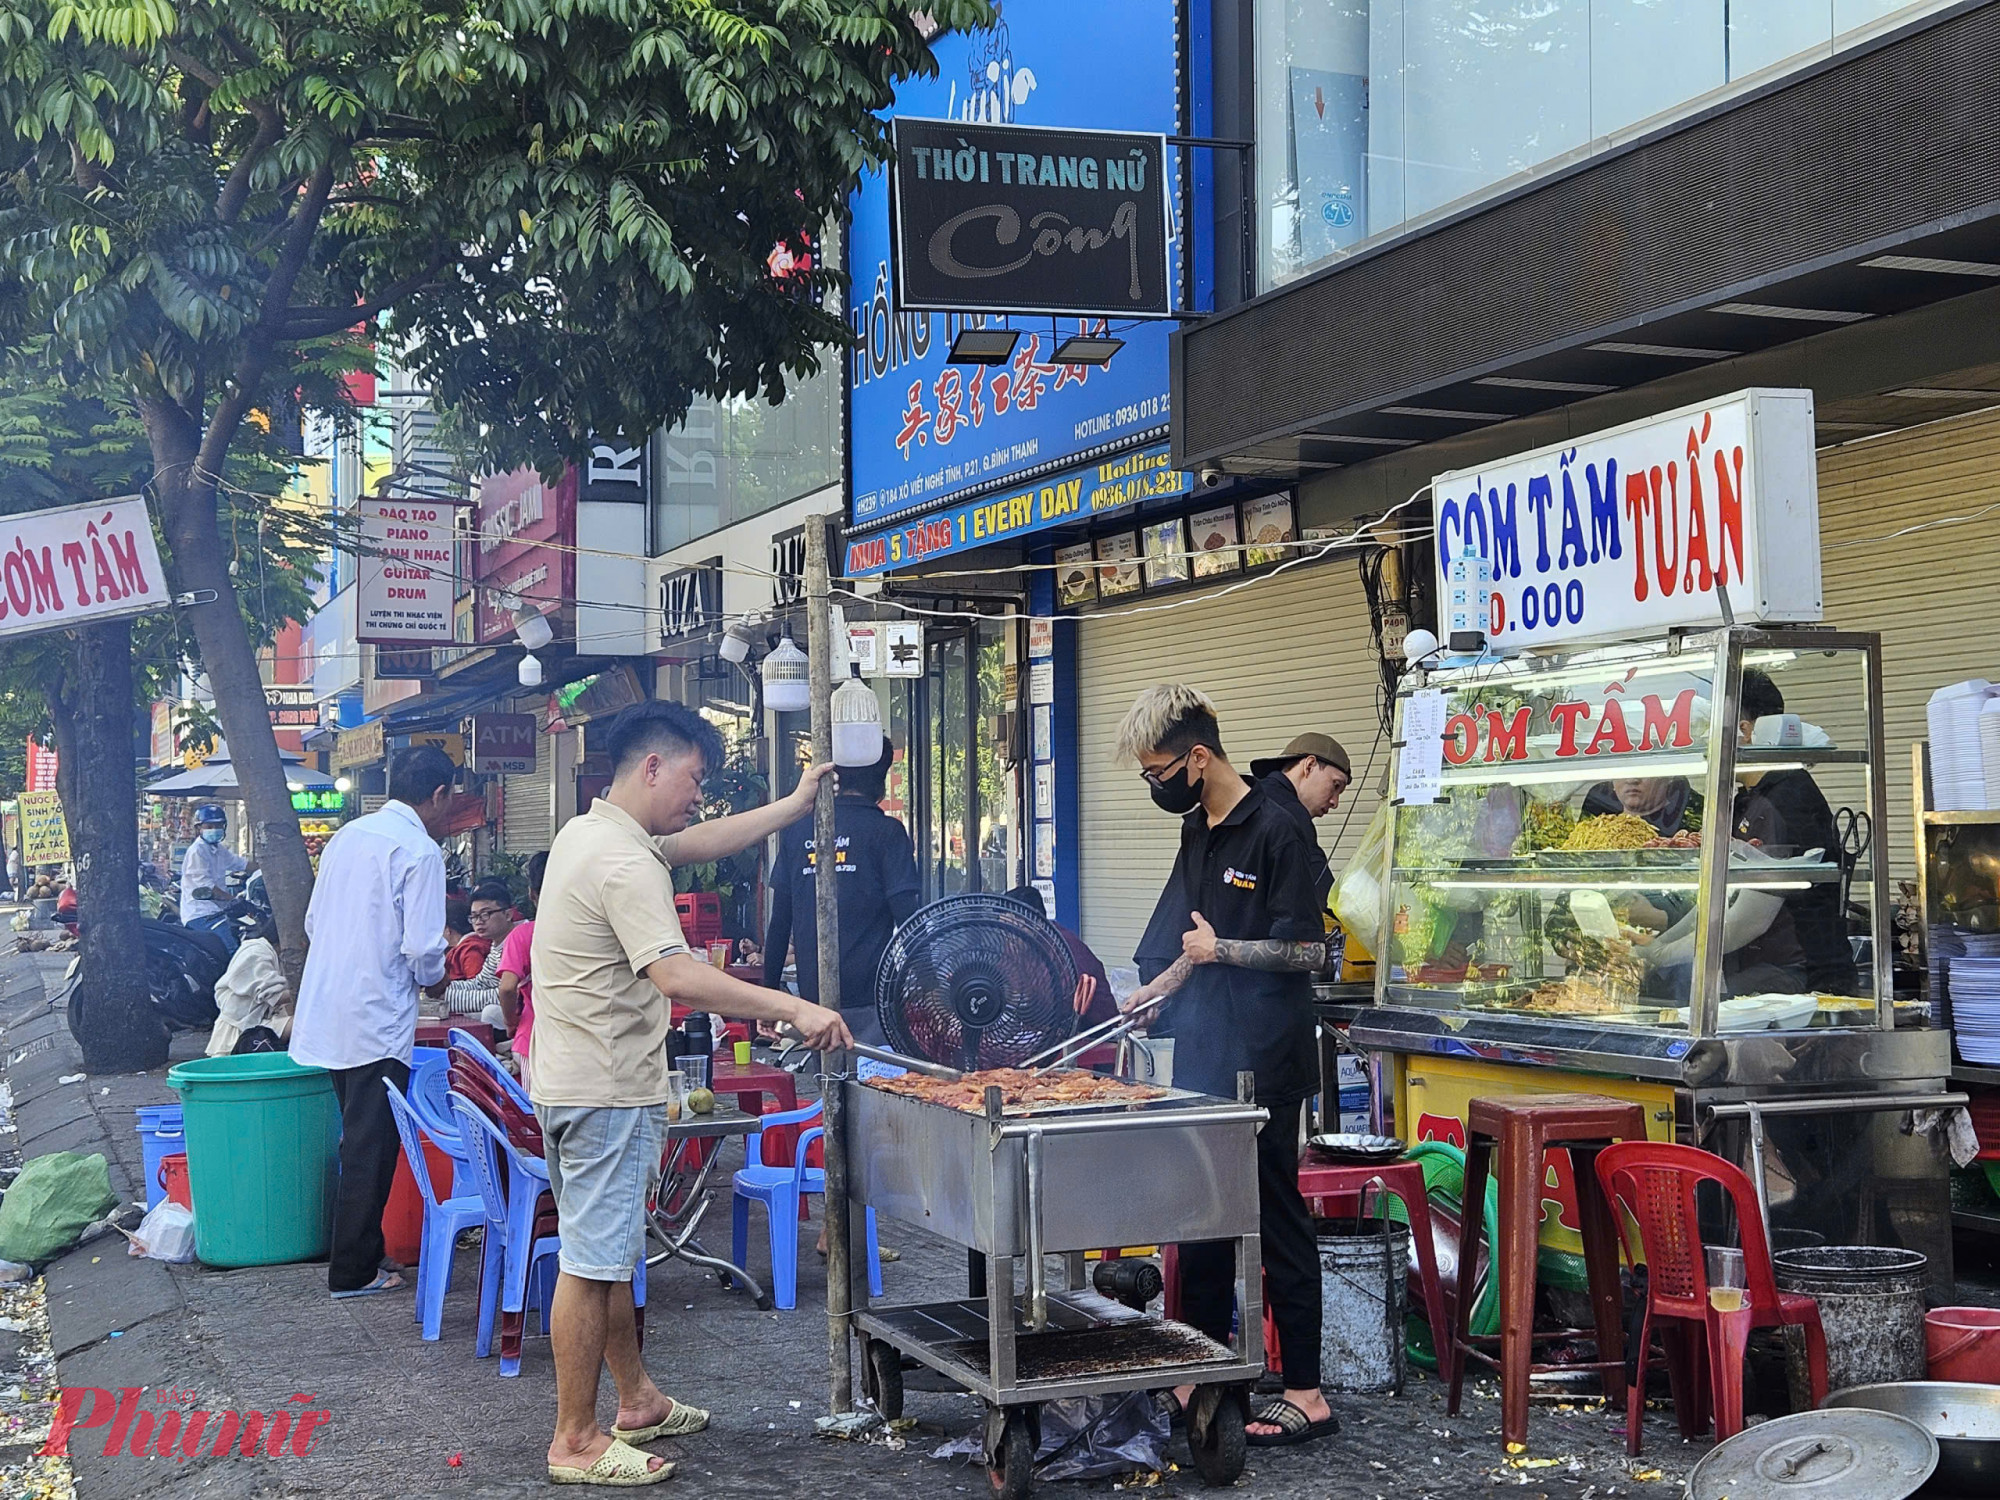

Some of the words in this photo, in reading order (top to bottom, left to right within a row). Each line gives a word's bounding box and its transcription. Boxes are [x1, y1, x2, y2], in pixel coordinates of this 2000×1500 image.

[911, 138, 989, 183] THỜI
[996, 152, 1099, 190] TRANG
[1106, 149, 1148, 192] NỮ
[928, 201, 1142, 300] Công
[853, 261, 931, 389] HỒNG
[1116, 404, 1138, 427] 0936
[1141, 397, 1158, 419] 018
[886, 490, 898, 505] 184
[899, 484, 909, 500] XÔ
[911, 473, 923, 496] VIẾT
[925, 468, 945, 491] NGHỆ
[1011, 438, 1038, 462] THẠNH
[1091, 471, 1184, 512] 0936.018.231
[1528, 446, 1622, 572] TẤM
[1626, 412, 1744, 602] TUẤN
[379, 507, 407, 521] ĐÀO
[412, 509, 437, 523] TẠO
[849, 539, 886, 573] MUA
[891, 534, 902, 561] 5
[906, 519, 951, 560] TẶNG
[957, 517, 967, 543] 1
[974, 493, 1036, 539] EVERY
[1041, 478, 1083, 520] DAY
[387, 528, 429, 540] PIANO
[63, 511, 148, 606] TẤM
[414, 549, 450, 563] NHẠC
[384, 568, 430, 580] GUITAR
[387, 587, 427, 599] DRUM
[657, 569, 705, 637] RUZA
[1490, 578, 1585, 637] 0.000
[366, 621, 377, 629] THI
[394, 611, 404, 619] THI
[1443, 702, 1531, 766] ƠM
[1550, 667, 1696, 757] TẤM
[479, 726, 532, 744] ATM
[503, 762, 526, 770] MSB
[27, 807, 48, 816] SINH
